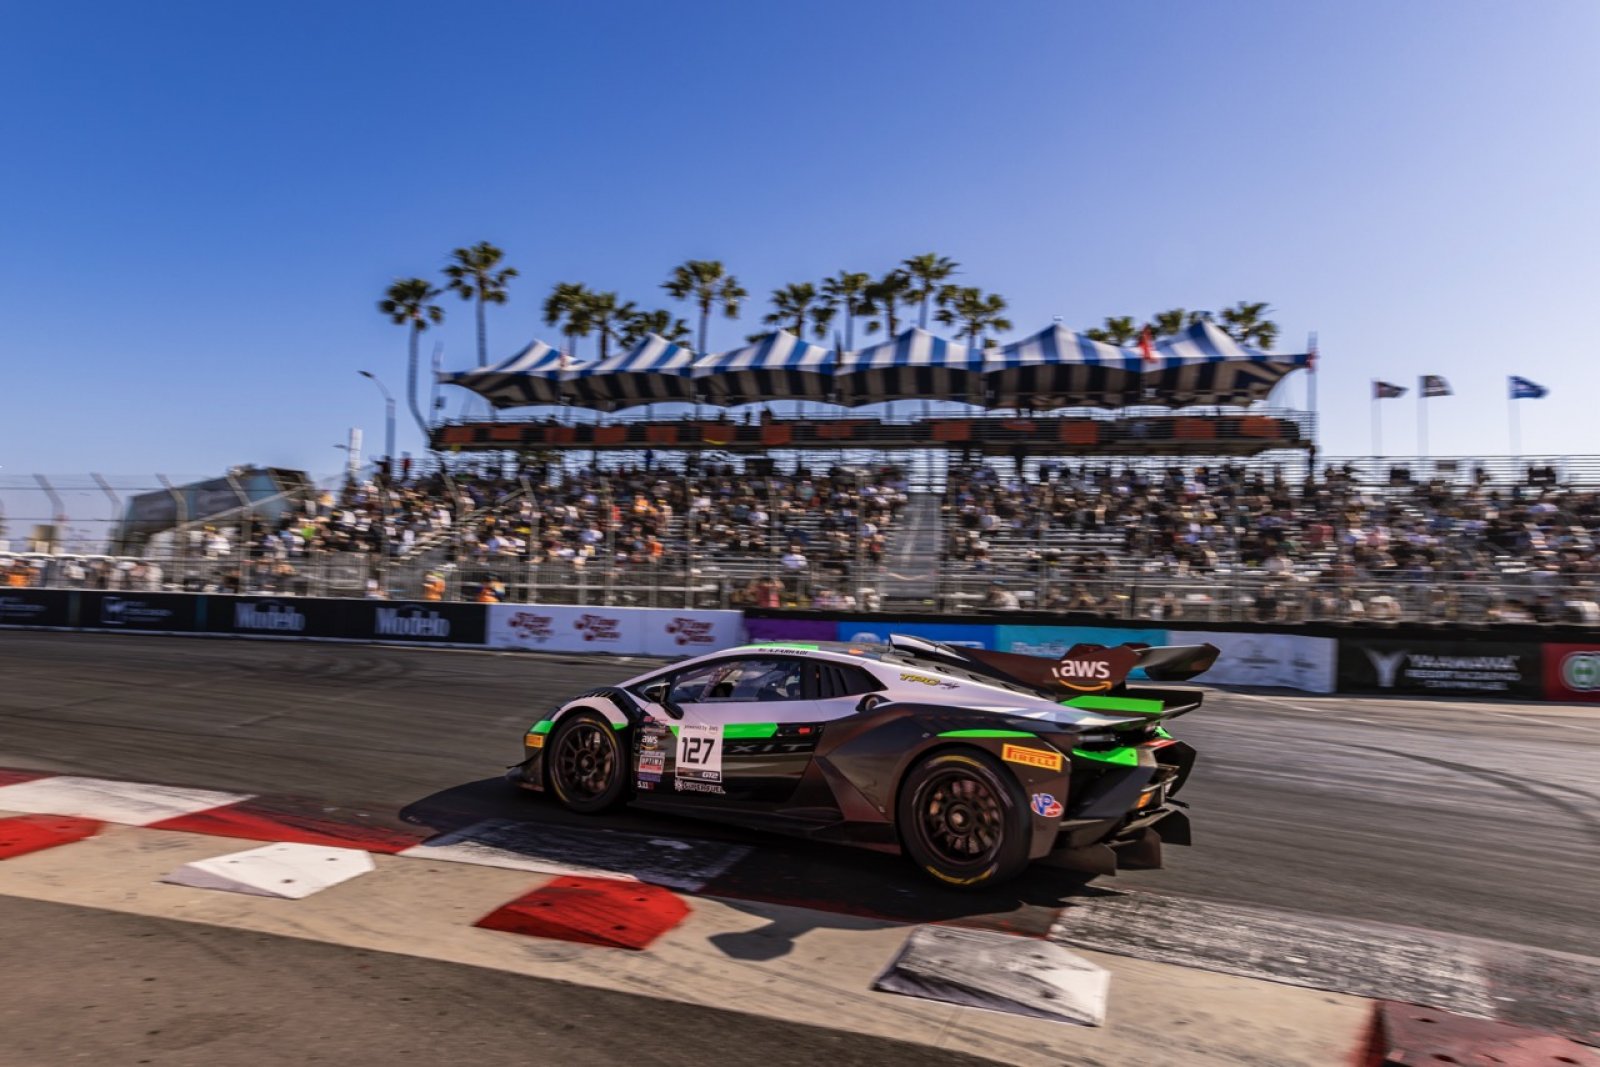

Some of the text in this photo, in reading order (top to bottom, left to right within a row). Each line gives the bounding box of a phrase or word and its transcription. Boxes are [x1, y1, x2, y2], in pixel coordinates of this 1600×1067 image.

[1060, 659, 1111, 679] aws
[641, 735, 658, 744] aws
[682, 737, 715, 764] 127
[1008, 747, 1057, 767] PIRELLI
